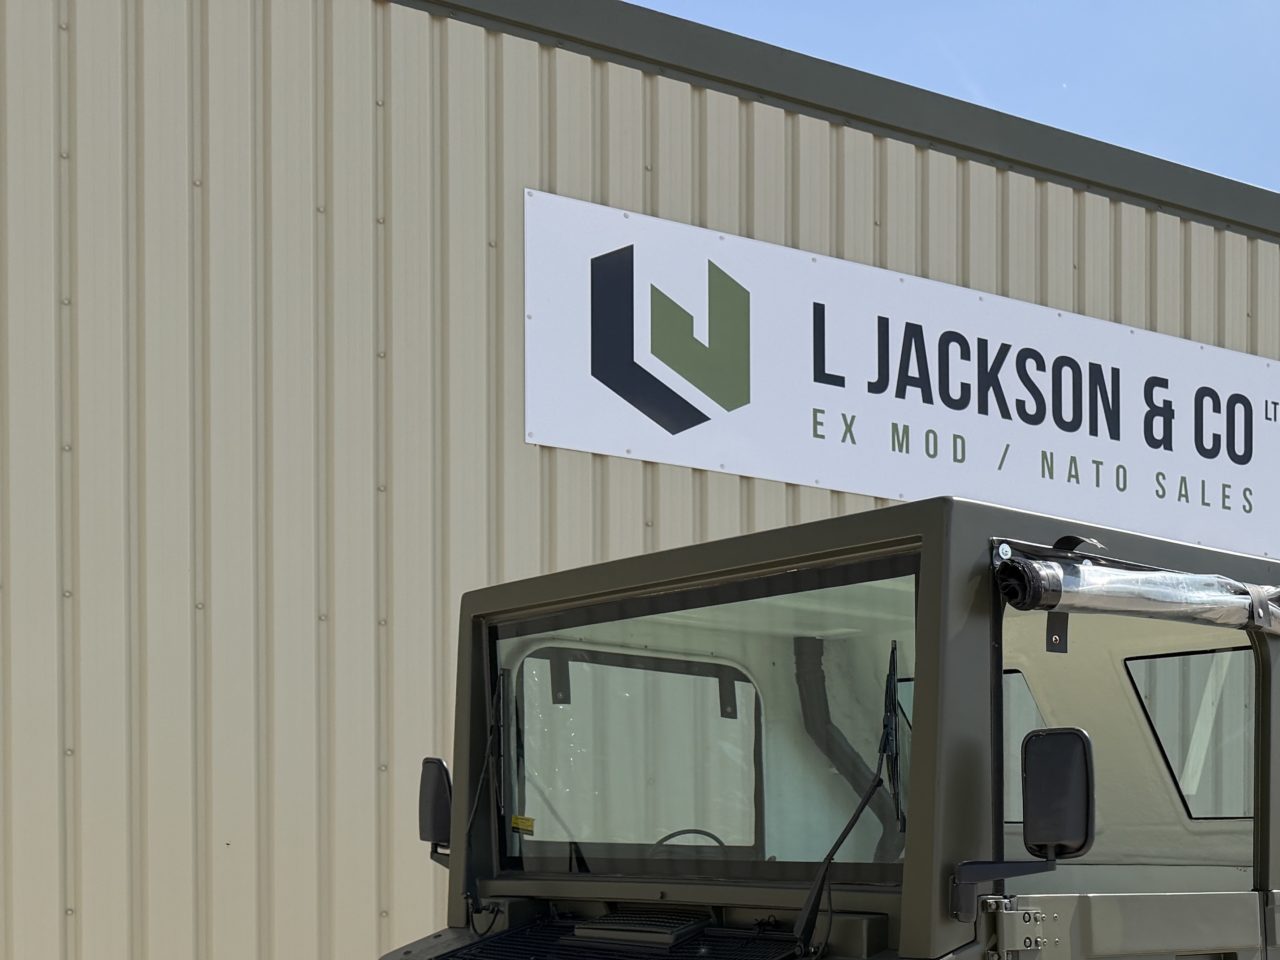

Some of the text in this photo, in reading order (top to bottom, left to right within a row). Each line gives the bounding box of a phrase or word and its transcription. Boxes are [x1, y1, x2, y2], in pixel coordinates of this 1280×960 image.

[812, 301, 846, 389] L
[866, 314, 1121, 442] JACKSON
[1143, 375, 1176, 453] &
[1193, 385, 1254, 466] CO
[812, 407, 1253, 514] EX MOD / NATO SALES
